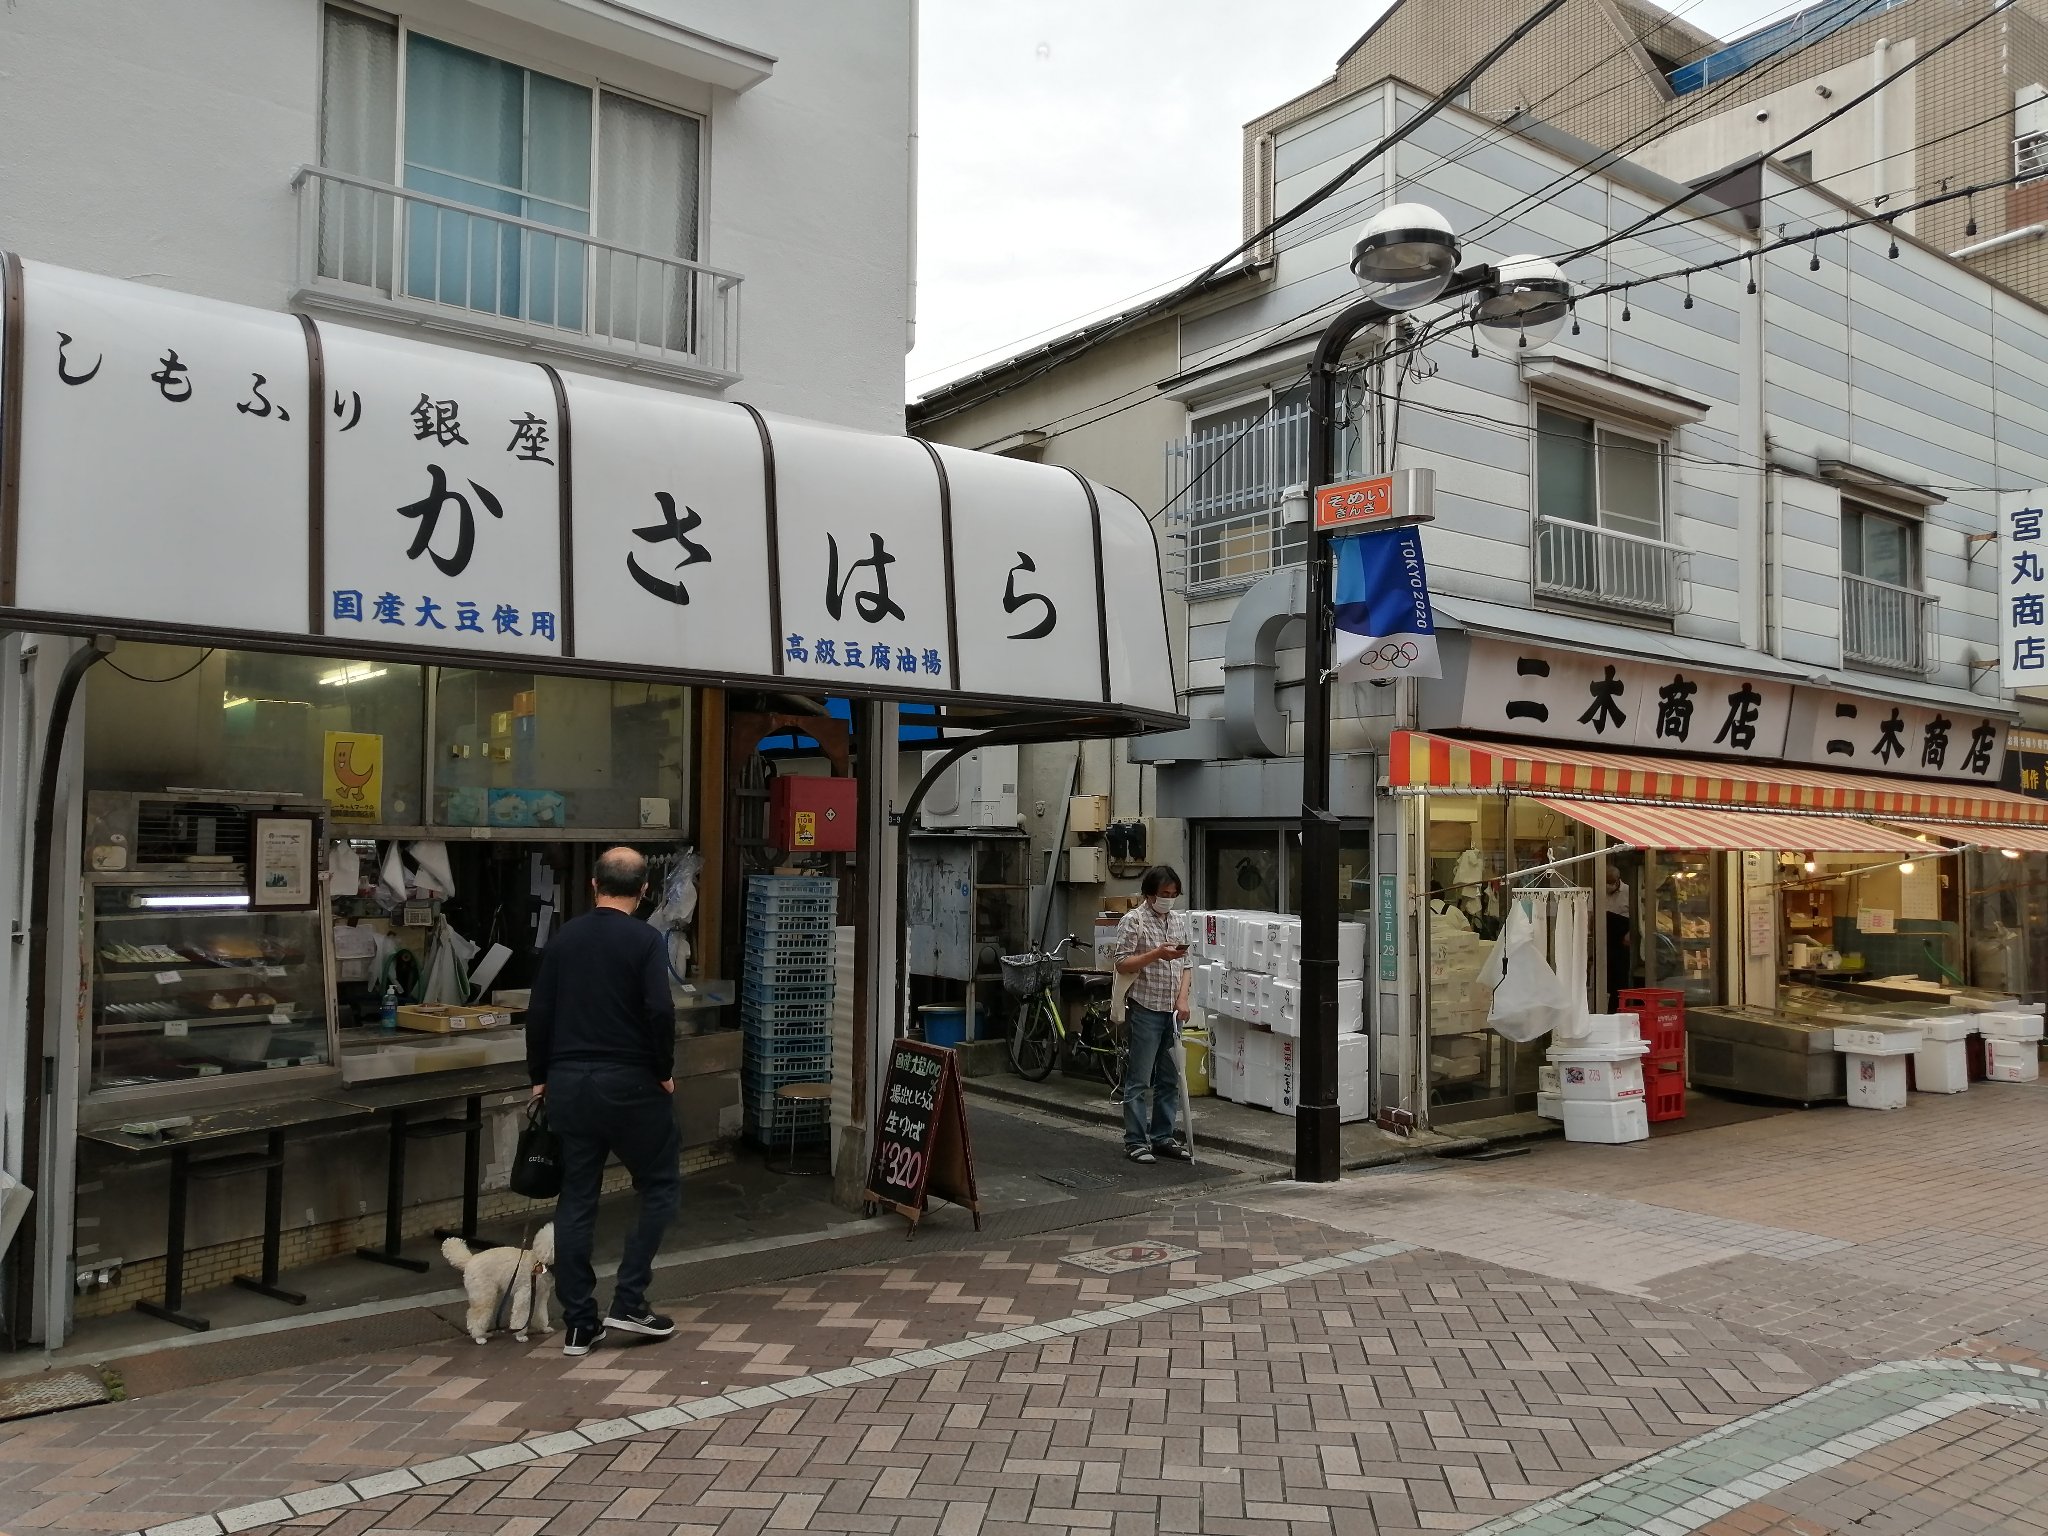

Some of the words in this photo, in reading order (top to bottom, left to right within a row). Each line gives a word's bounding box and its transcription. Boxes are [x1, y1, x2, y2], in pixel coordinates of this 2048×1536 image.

[56, 330, 555, 466] しもふり銀座
[1328, 487, 1385, 507] そめい
[1336, 501, 1375, 519] ぎんざ
[397, 463, 1057, 640] かさはら
[1400, 540, 1422, 588] TOKYO
[1412, 591, 1428, 629] 2020
[2009, 506, 2047, 671] 宮丸商店
[332, 589, 556, 642] 国産大豆使用
[785, 632, 943, 677] 高級豆腐油揚
[1505, 655, 1763, 751] 二木商店
[1825, 702, 1997, 777] 二木商店
[1384, 888, 1393, 942] 駒込三丁目
[1383, 944, 1395, 956] 29
[884, 1109, 926, 1142] 生ゆば
[878, 1141, 923, 1190] ¥320
